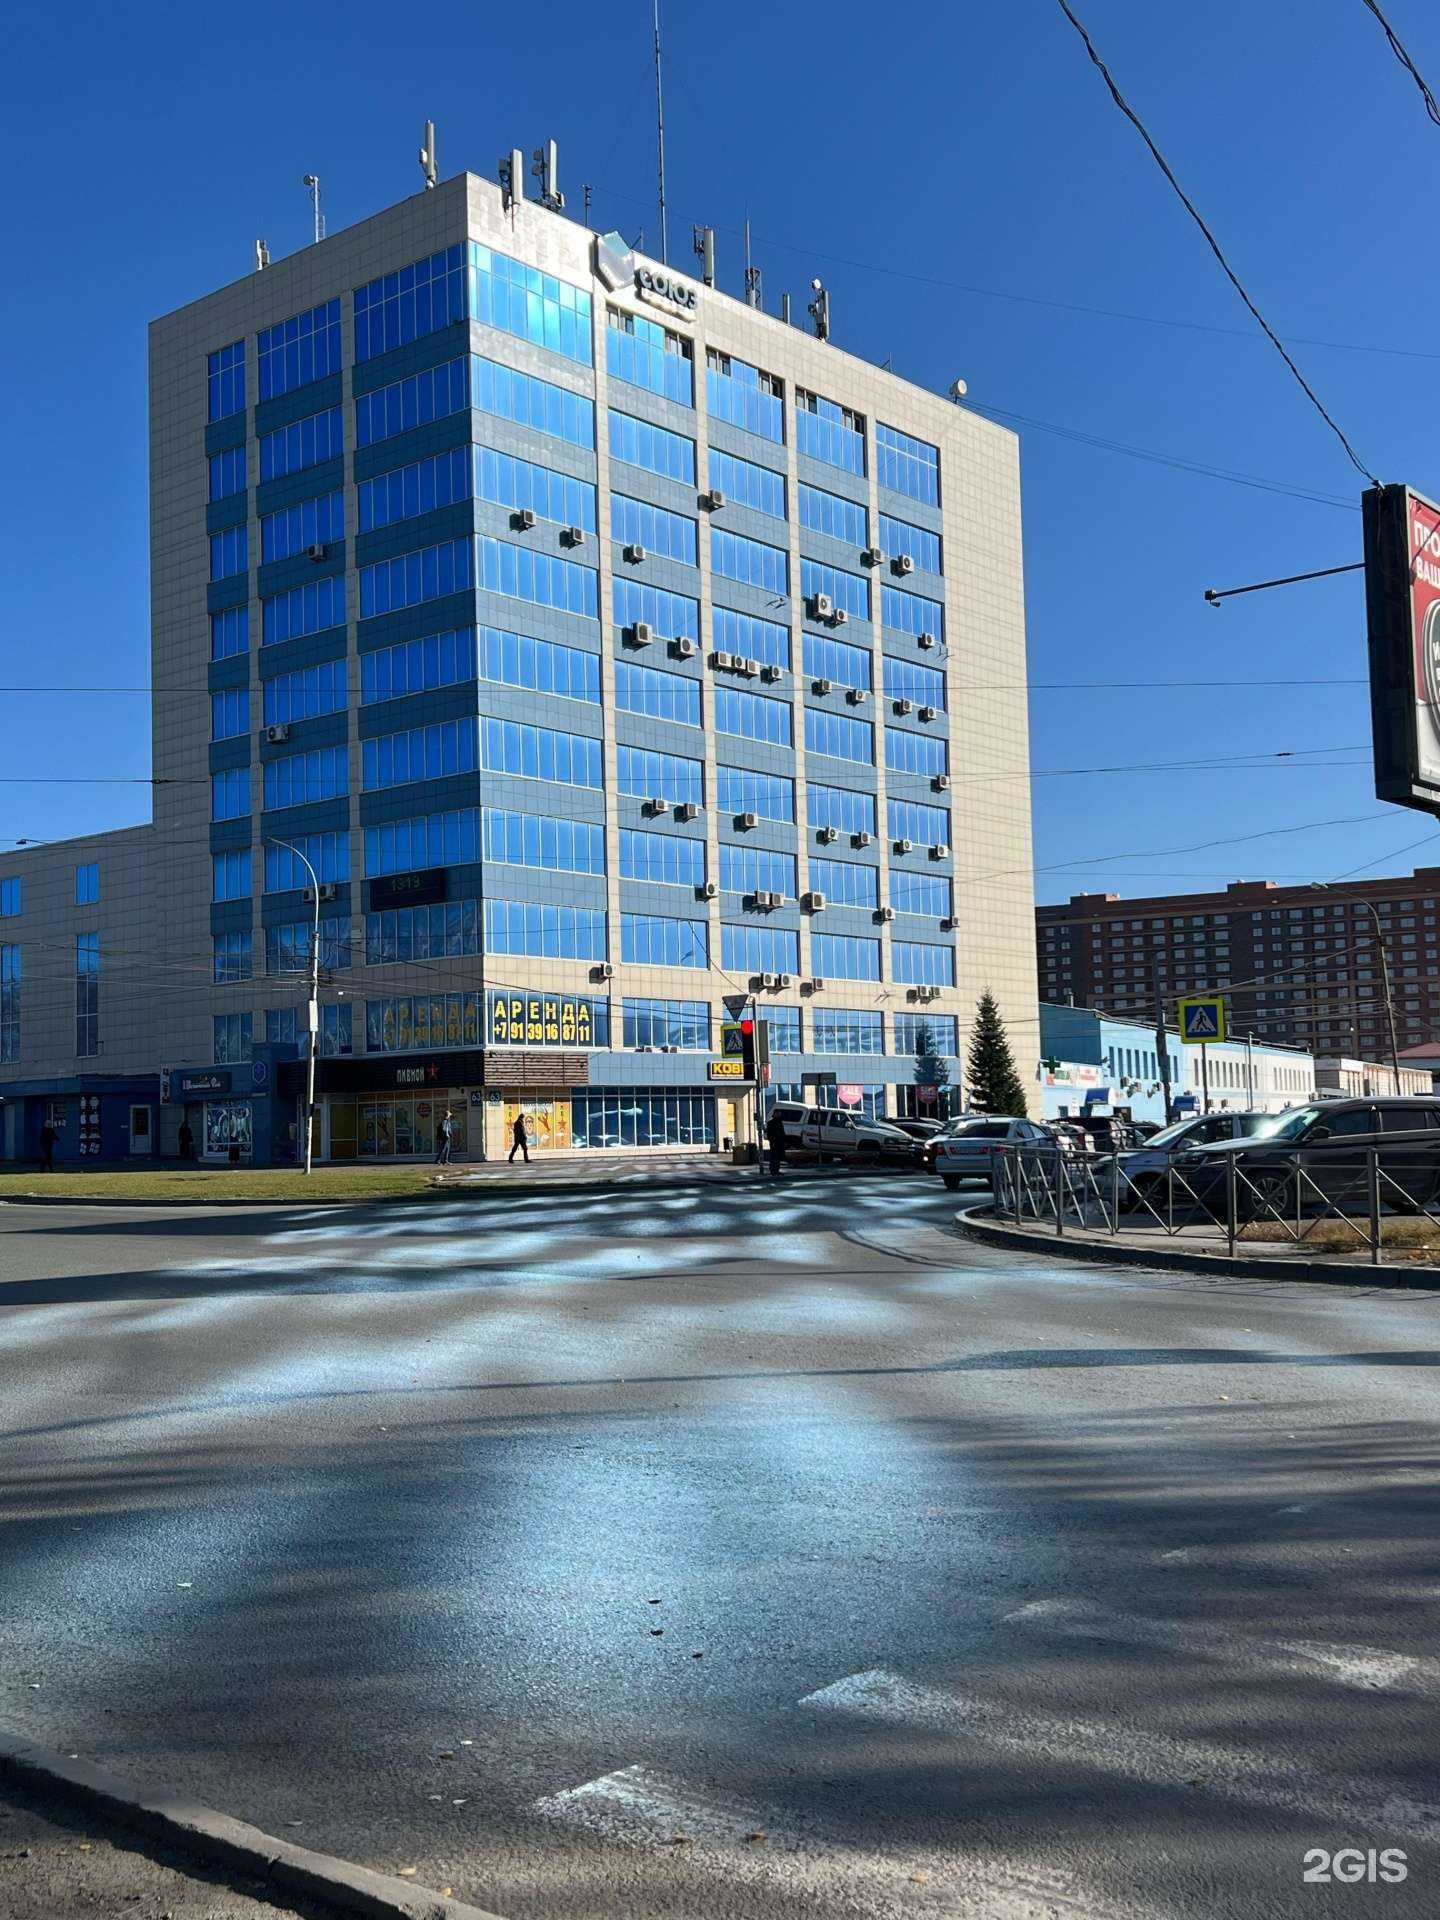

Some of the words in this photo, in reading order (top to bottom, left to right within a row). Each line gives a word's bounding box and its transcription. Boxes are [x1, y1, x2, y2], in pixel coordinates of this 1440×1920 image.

[637, 266, 698, 310] СОЮЗ
[494, 1000, 590, 1024] АРЕНДА
[713, 1063, 744, 1074] КОВ
[471, 1092, 482, 1102] 63
[490, 1091, 501, 1102] 63
